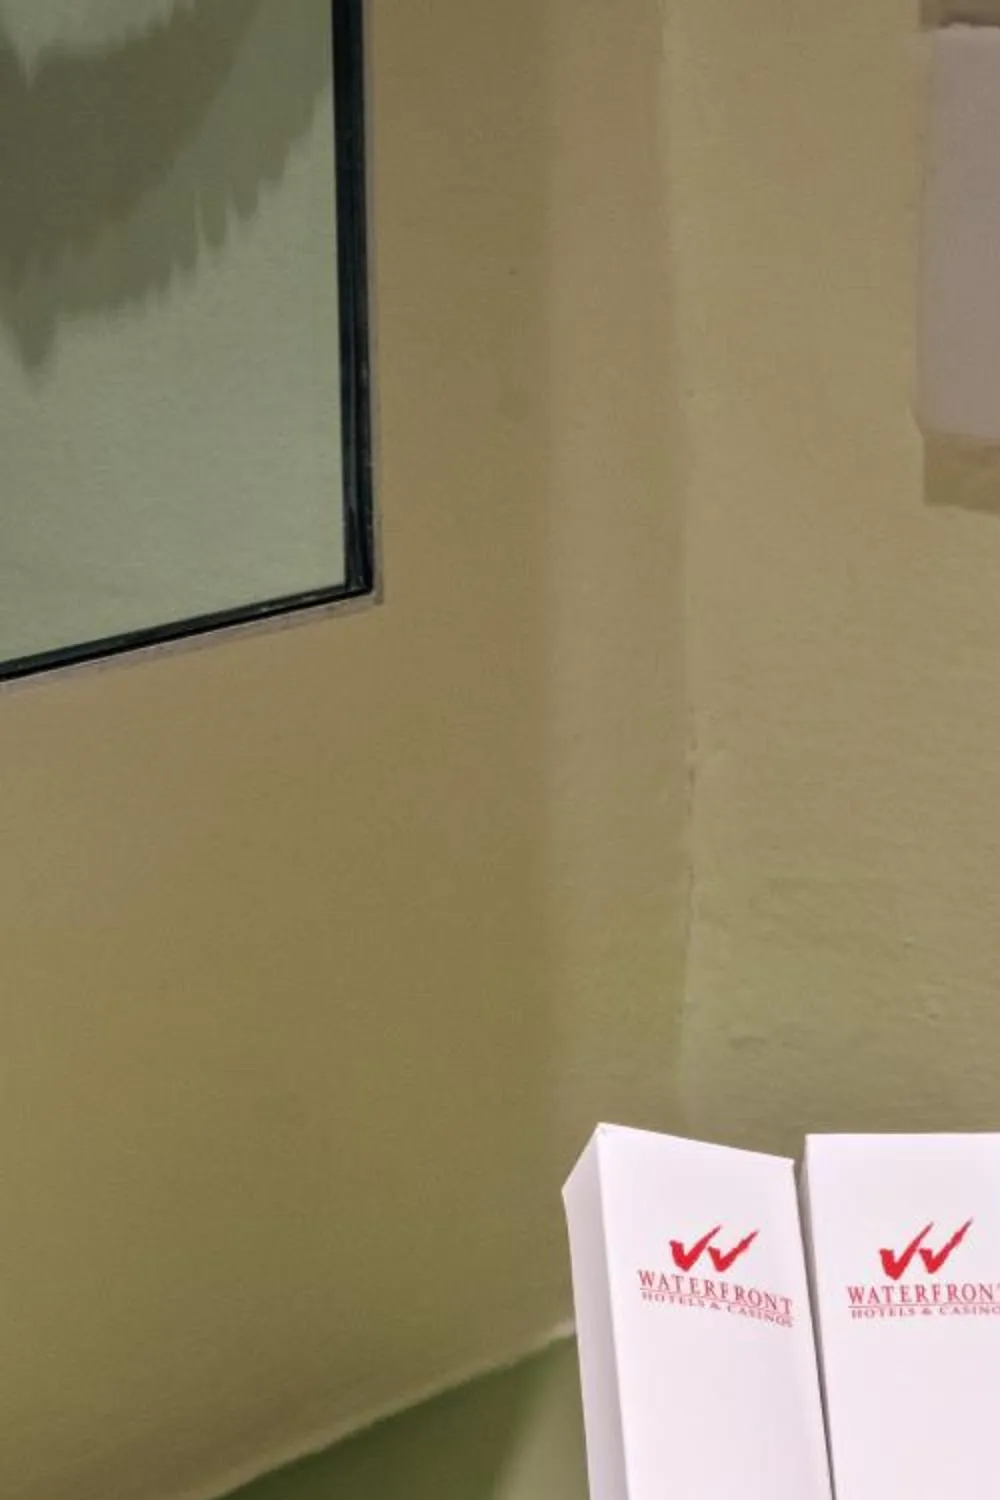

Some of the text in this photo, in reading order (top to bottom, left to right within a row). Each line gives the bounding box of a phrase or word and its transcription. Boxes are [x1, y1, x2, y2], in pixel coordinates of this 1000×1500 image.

[637, 1269, 793, 1314] WATERFRONT
[641, 1290, 706, 1310] HOTELS
[727, 1305, 794, 1328] CASINOS
[850, 1307, 916, 1319] HOTELS
[921, 1307, 933, 1316] &
